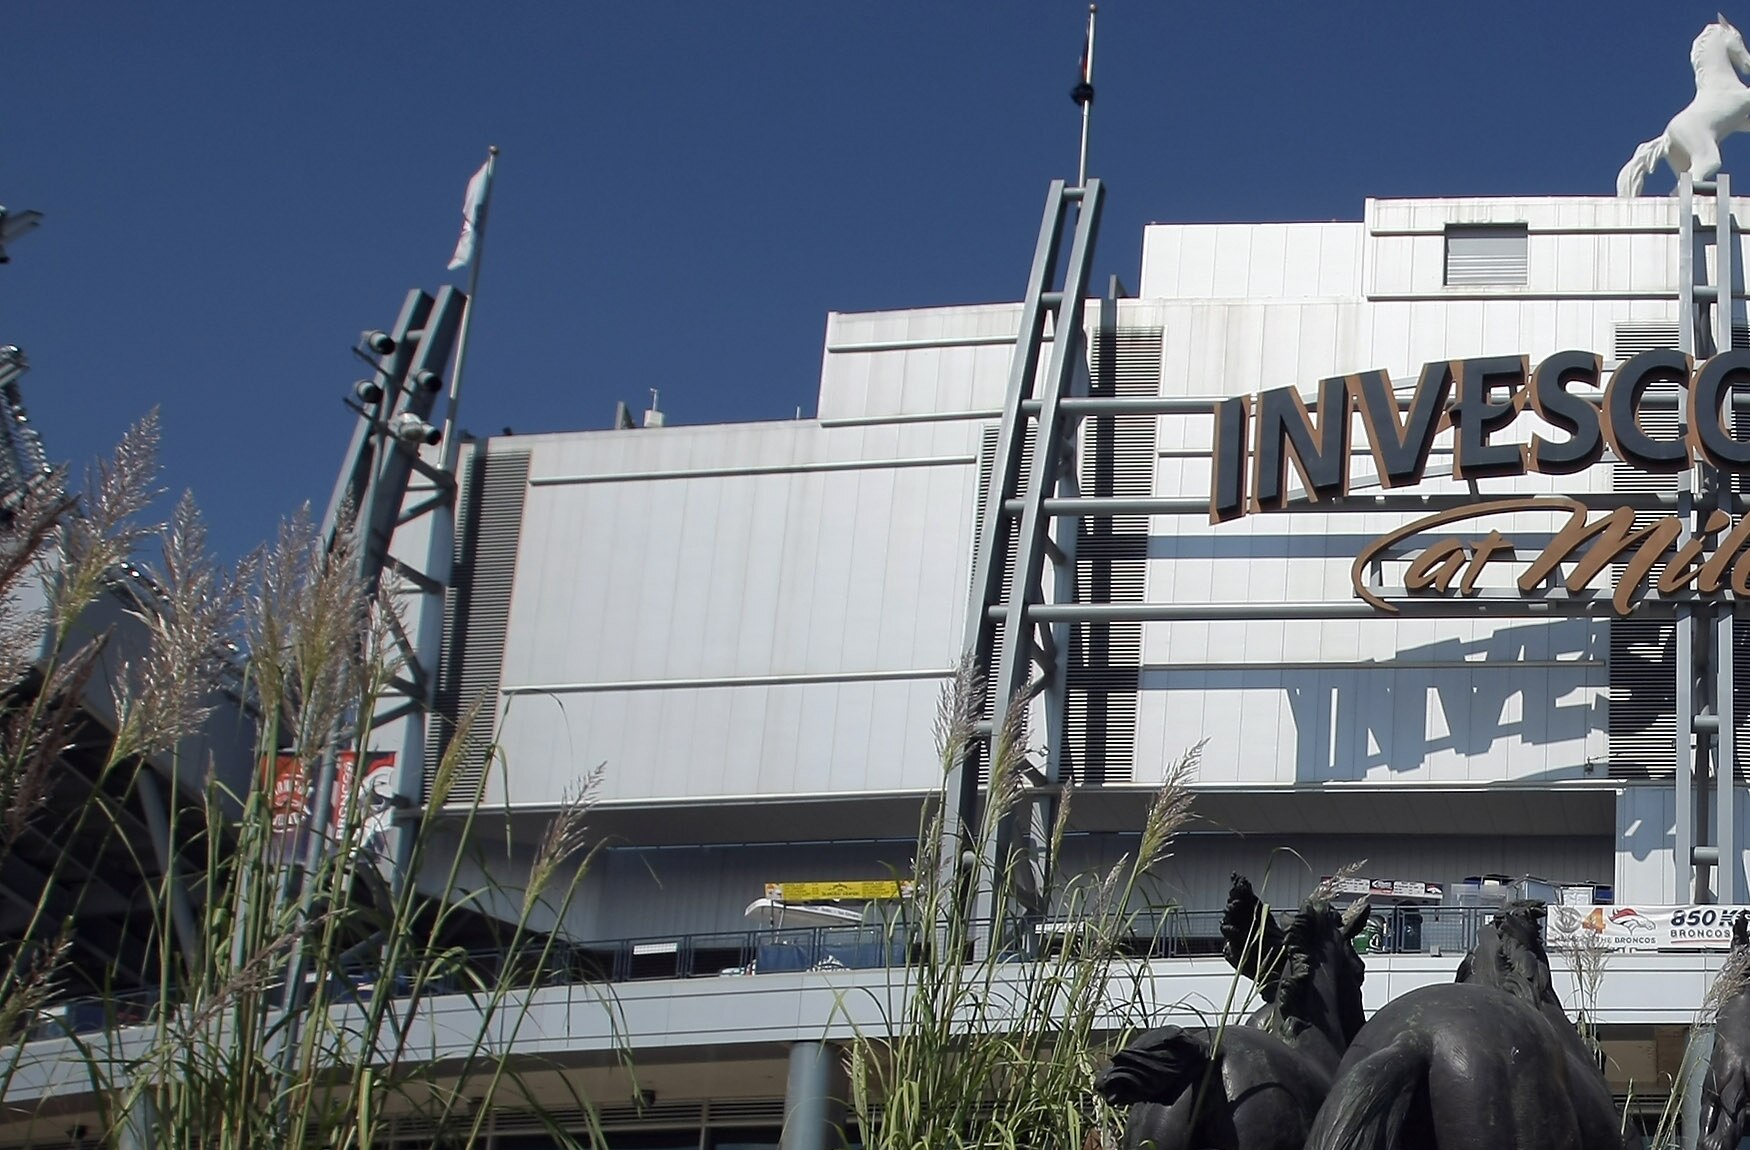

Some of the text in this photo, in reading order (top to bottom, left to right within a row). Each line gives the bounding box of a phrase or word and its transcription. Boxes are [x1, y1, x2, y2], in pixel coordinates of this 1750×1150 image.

[1583, 907, 1607, 935] 4
[1670, 909, 1717, 926] 850
[1614, 936, 1657, 944] BRONCOS
[1670, 929, 1731, 938] BRONCOS
